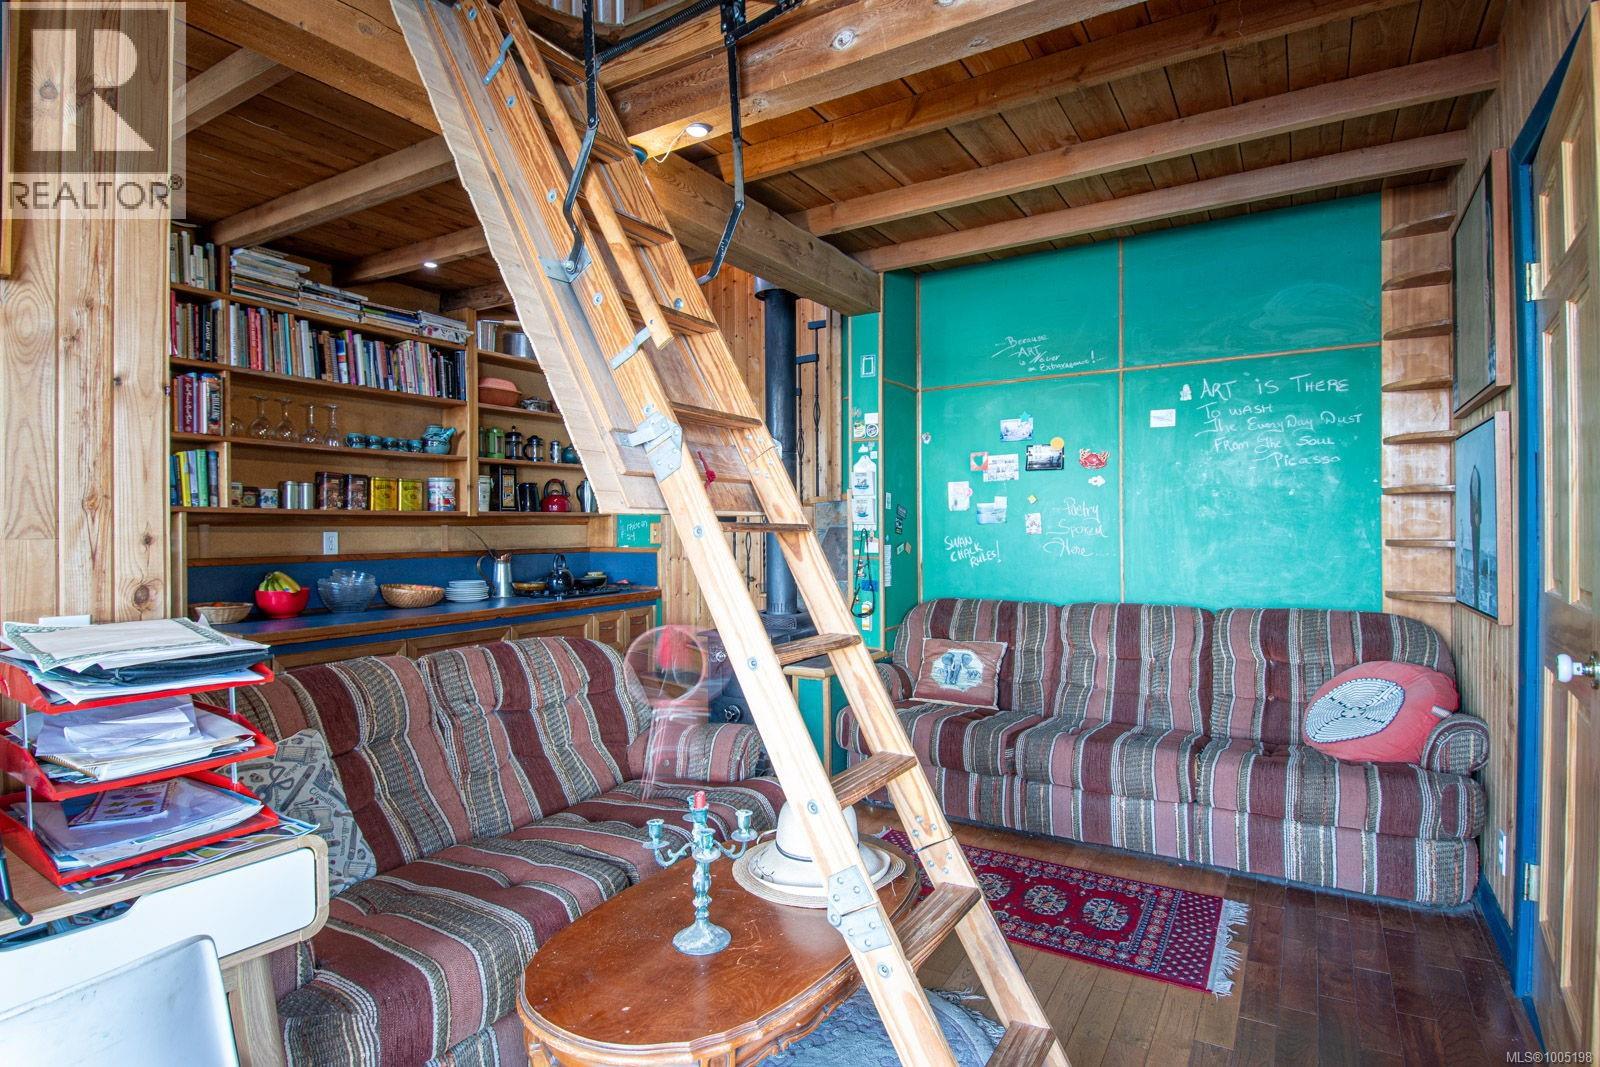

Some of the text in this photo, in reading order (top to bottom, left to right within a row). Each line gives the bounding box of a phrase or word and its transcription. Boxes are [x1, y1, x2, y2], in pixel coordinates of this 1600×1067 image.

[1013, 344, 1041, 358] ART
[1200, 378, 1237, 400] ART
[944, 535, 974, 551] SWAN
[950, 542, 984, 562] CHALK
[970, 539, 1002, 568] RULES!
